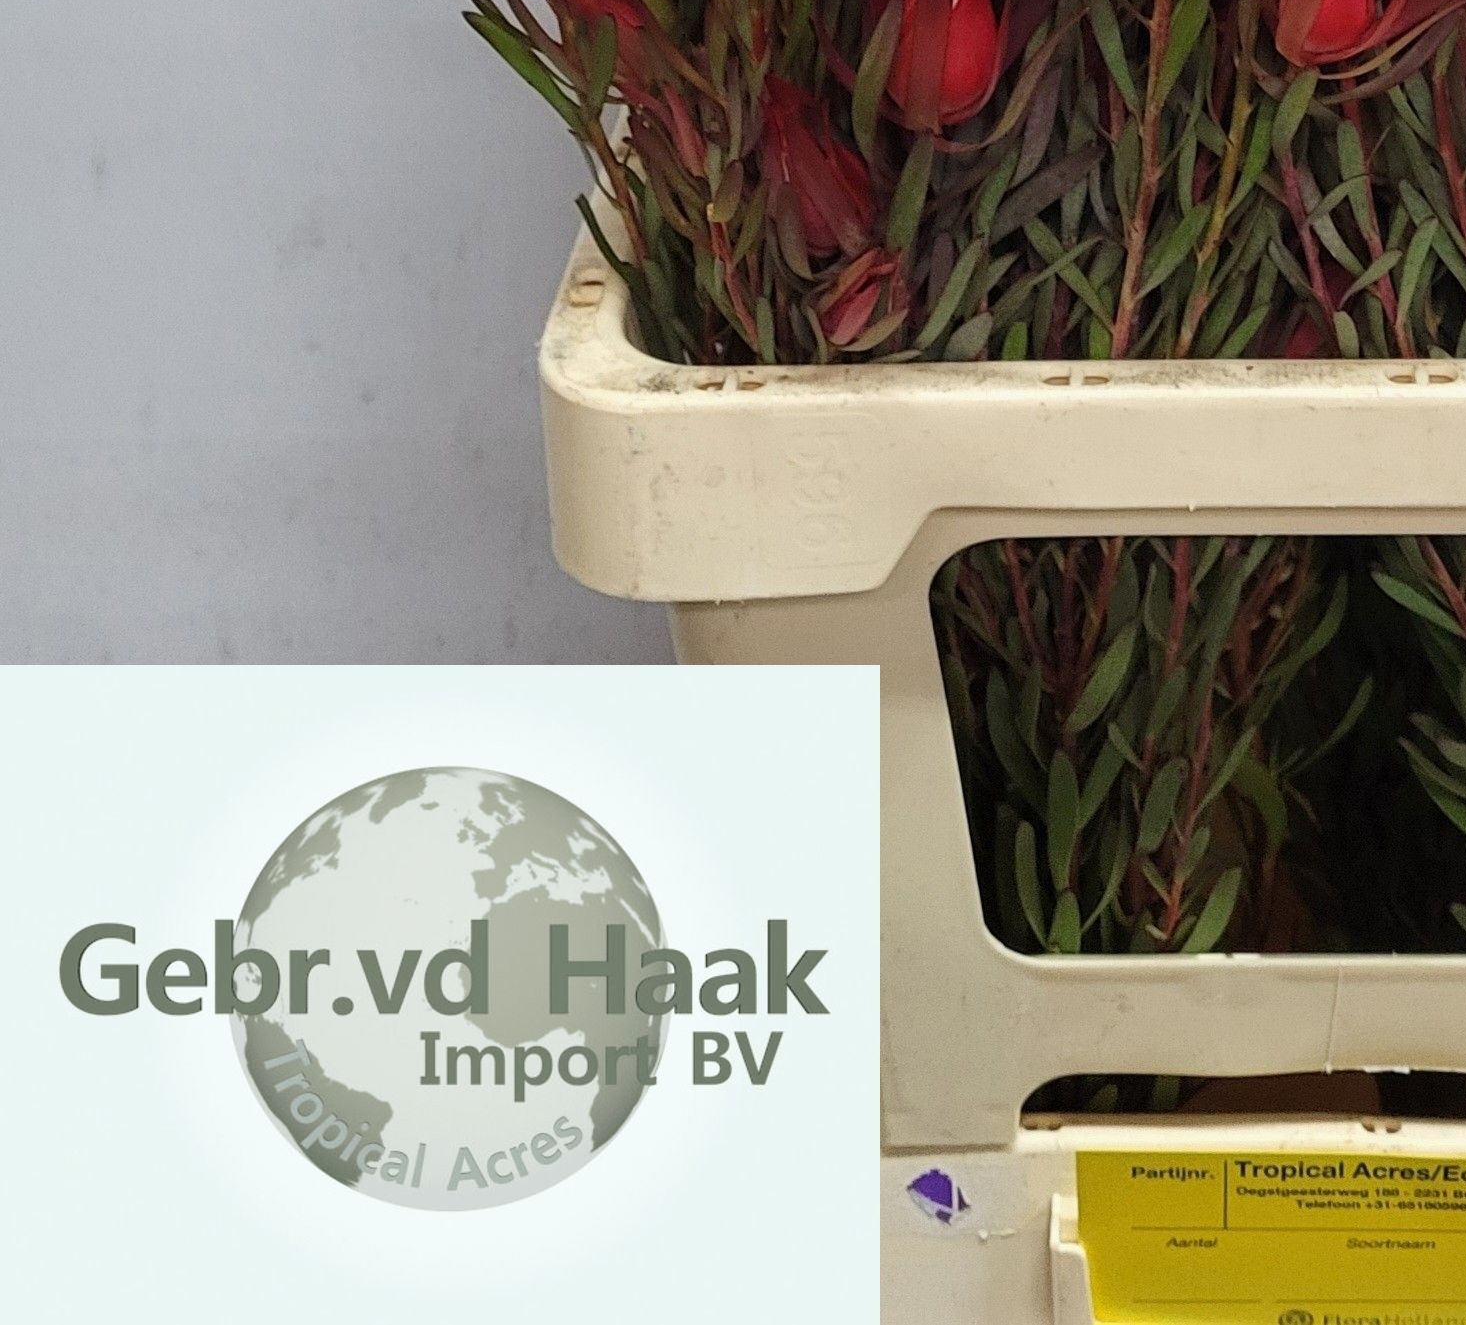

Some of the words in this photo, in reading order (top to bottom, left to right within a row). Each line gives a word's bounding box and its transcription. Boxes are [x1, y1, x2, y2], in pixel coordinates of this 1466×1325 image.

[1131, 1166, 1215, 1182] Partijnr.
[1235, 1160, 1345, 1182] Tropical
[1296, 1199, 1360, 1210] Telefoon
[1166, 1237, 1218, 1249] Aantal
[1346, 1237, 1436, 1249] Soortnaam
